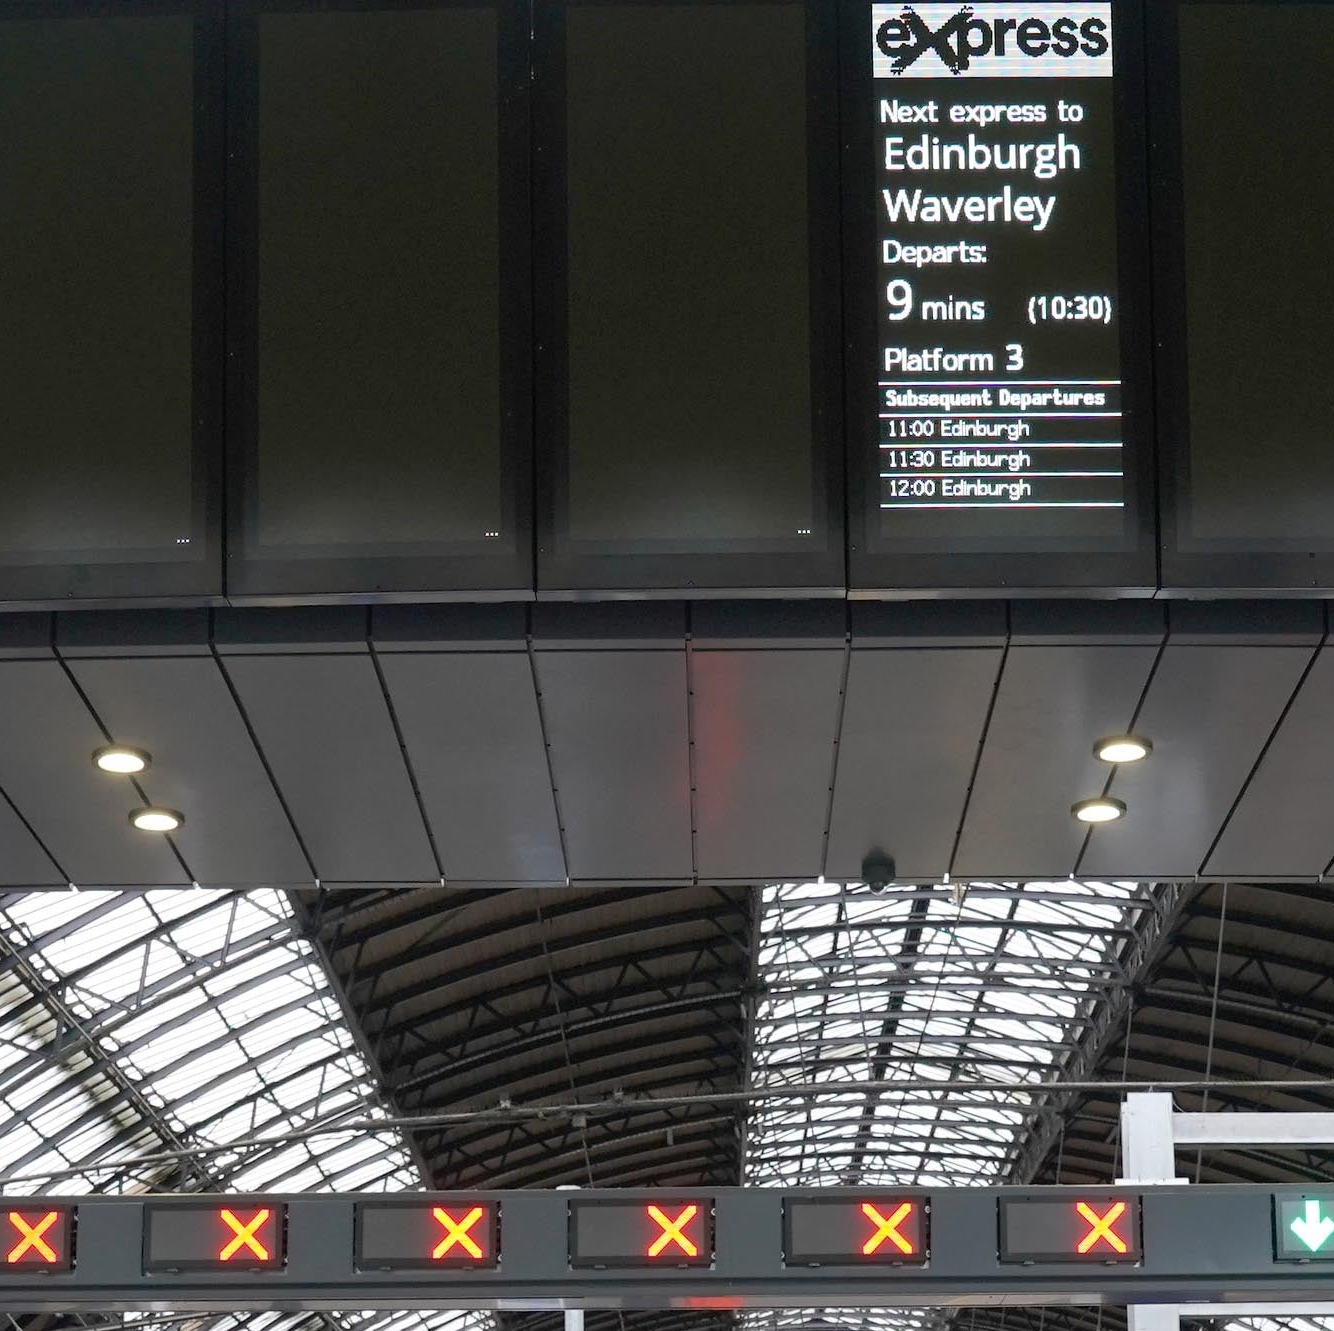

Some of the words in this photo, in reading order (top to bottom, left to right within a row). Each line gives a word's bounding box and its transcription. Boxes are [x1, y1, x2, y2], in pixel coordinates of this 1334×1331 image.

[876, 6, 1110, 75] express
[880, 99, 939, 123] Next
[949, 104, 1047, 128] express
[1057, 99, 1084, 122] to
[884, 133, 1081, 179] Edinburgh
[882, 185, 1057, 231] Waverley
[882, 239, 987, 268] Departs:
[886, 278, 913, 321] 9
[921, 294, 985, 321] mins
[1027, 295, 1112, 325] (10:30)
[884, 347, 994, 372] Platform
[1005, 343, 1024, 371] 3
[885, 388, 993, 412] Subsequent
[998, 388, 1106, 411] Departures
[889, 419, 935, 438] 11:00
[940, 418, 1030, 442] Edinburgh
[889, 450, 935, 468] 11:30
[941, 449, 1031, 472] Edinburgh
[890, 479, 936, 497] 12:00
[941, 478, 1031, 501] Edinburgh
